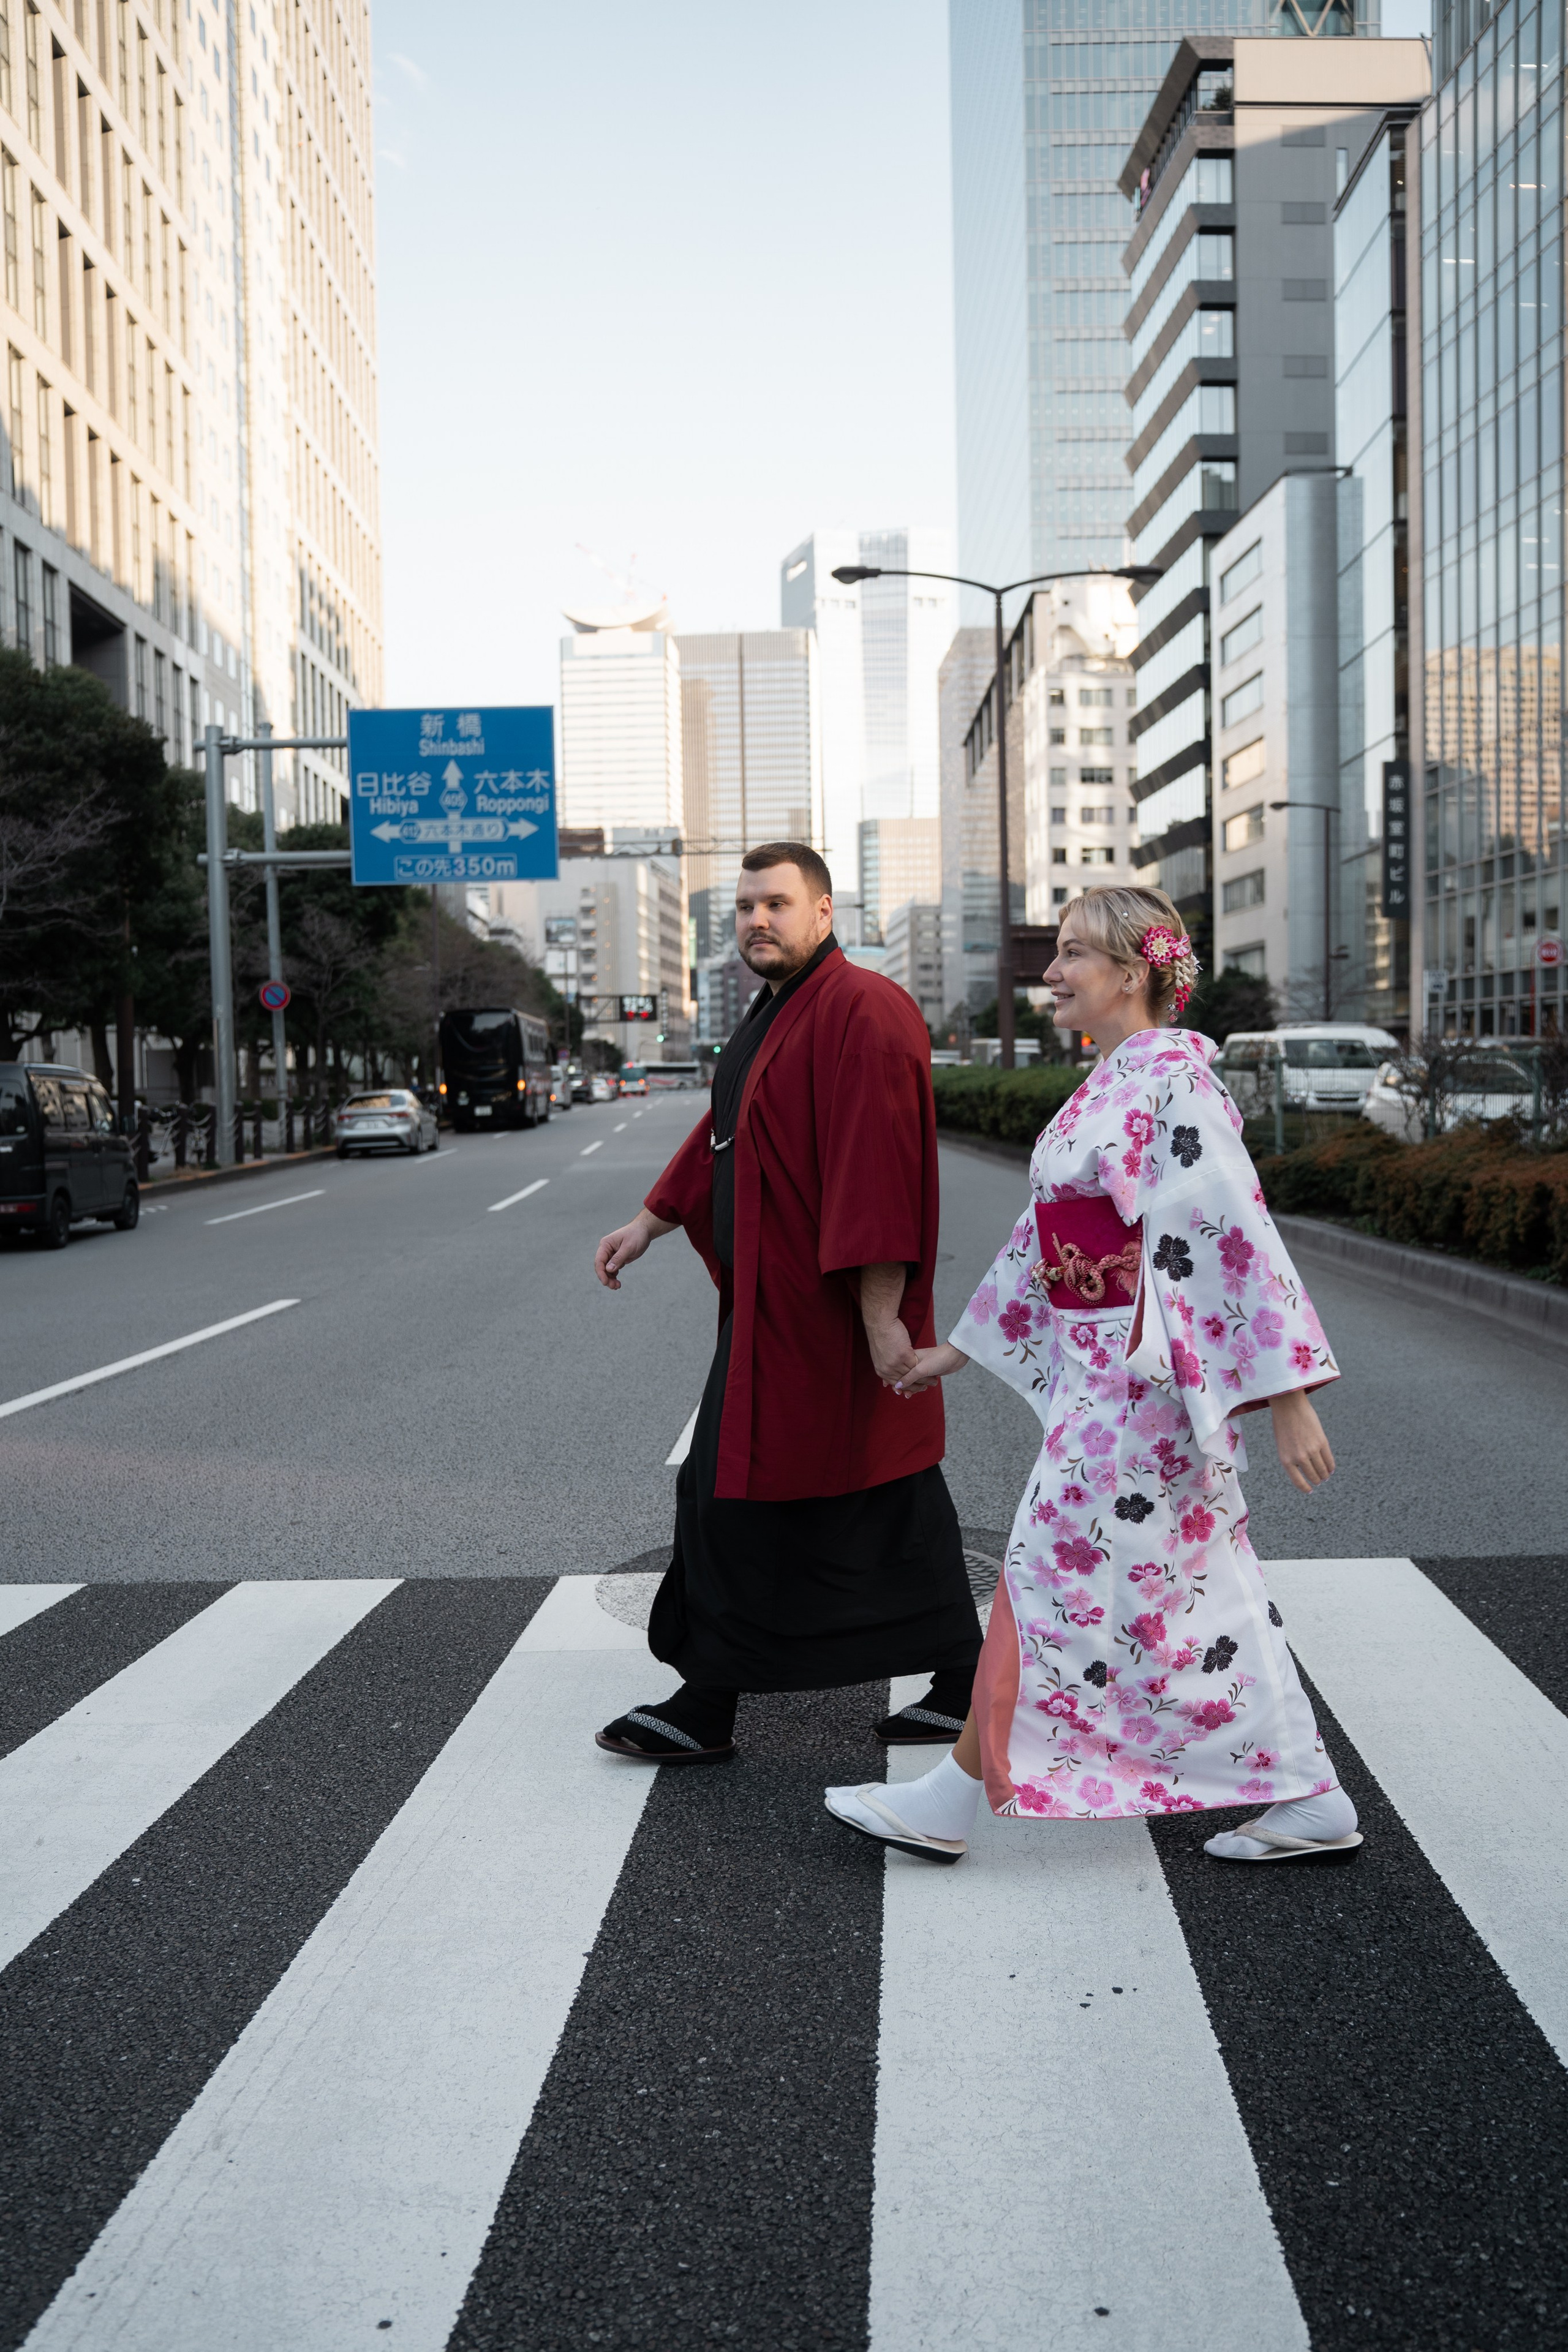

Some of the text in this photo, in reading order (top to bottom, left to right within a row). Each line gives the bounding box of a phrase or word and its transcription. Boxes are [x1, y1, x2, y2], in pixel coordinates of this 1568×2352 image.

[421, 713, 481, 737] 新橋
[419, 738, 484, 756] Shinbashi
[356, 772, 432, 797] 日比谷
[474, 769, 550, 793] 六本木
[369, 797, 419, 817] Hibiya
[477, 794, 549, 815] Roppongi
[424, 823, 500, 838] 六本木通り
[1388, 774, 1405, 905] 赤坂室町ビル
[398, 858, 515, 877] この先350m
